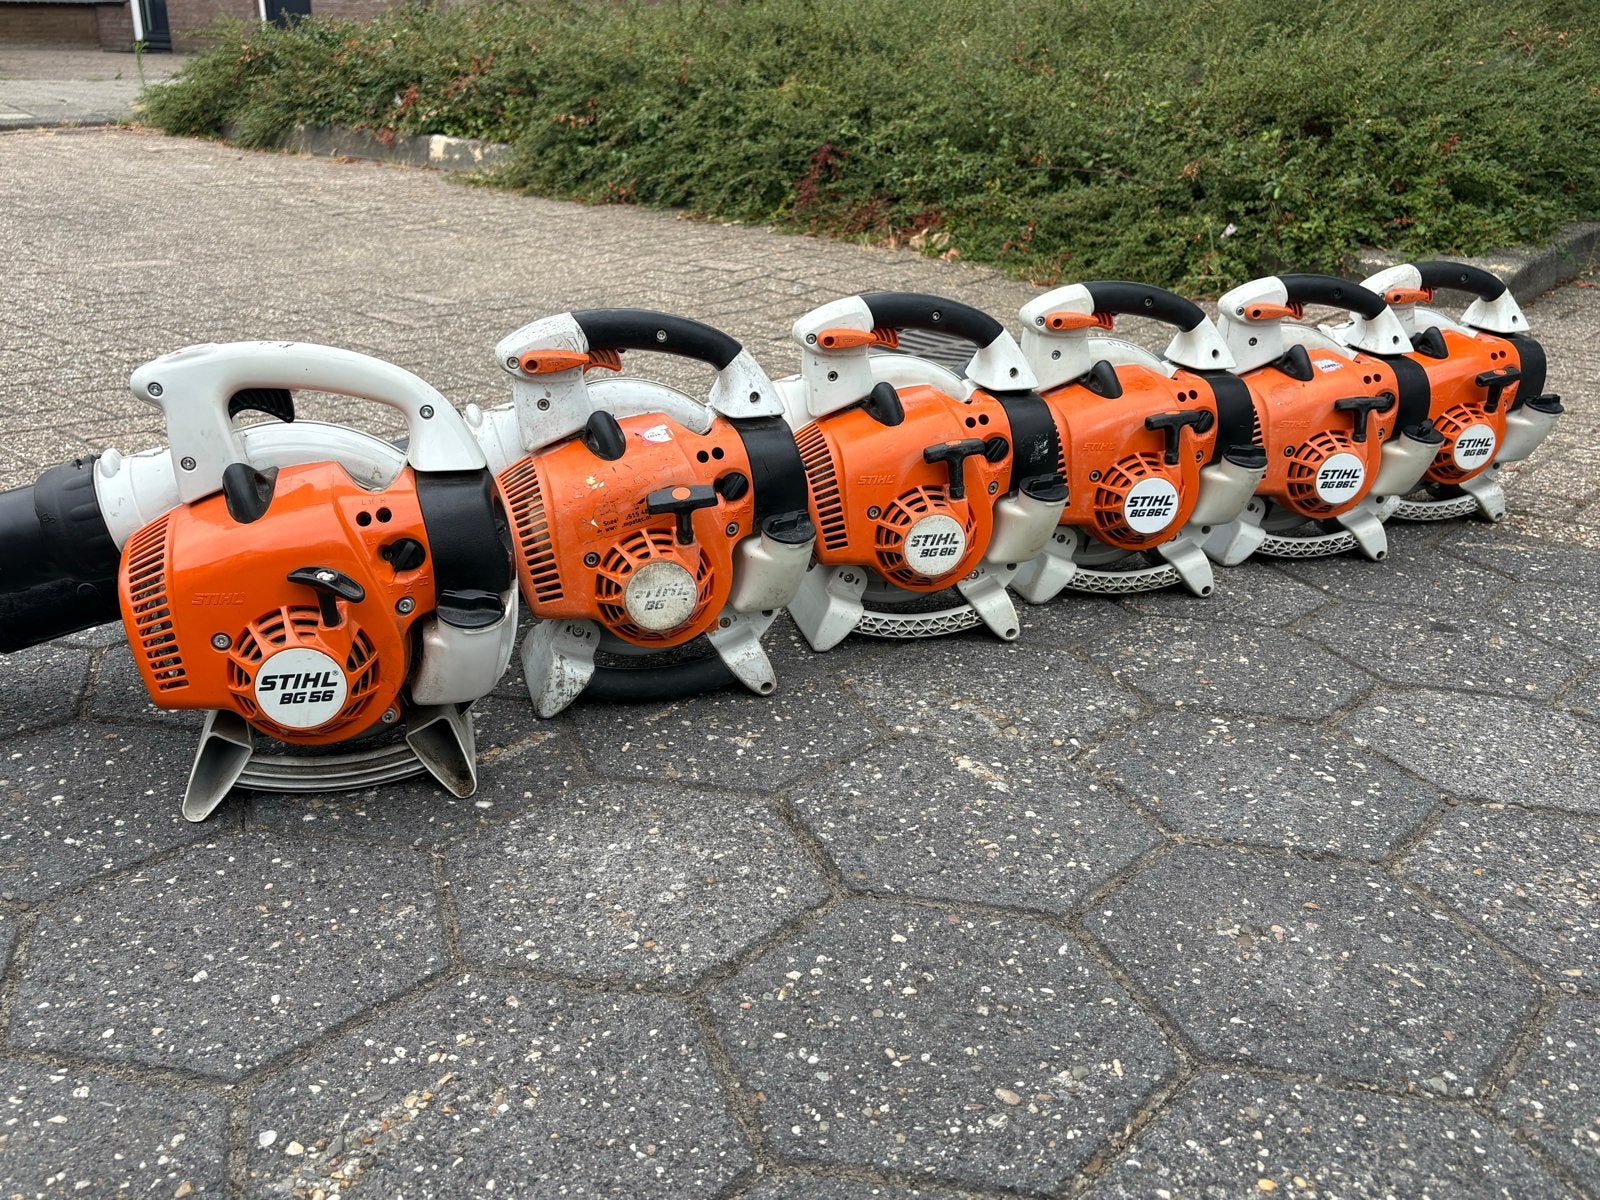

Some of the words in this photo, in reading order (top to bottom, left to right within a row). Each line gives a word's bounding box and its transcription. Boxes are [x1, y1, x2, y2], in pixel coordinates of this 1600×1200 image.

[1081, 442, 1115, 452] STIHL
[1456, 438, 1492, 449] STIHL
[1318, 469, 1360, 480] STIHL
[858, 475, 894, 486] STIHL
[1320, 481, 1337, 489] BG
[1127, 495, 1174, 508] STIHL
[1129, 508, 1147, 518] BG
[911, 533, 960, 548] STIHL
[920, 548, 939, 559] BG
[191, 592, 245, 606] STIHL
[259, 671, 338, 692] STIHL
[279, 692, 308, 705] BG
[308, 690, 335, 703] 56
